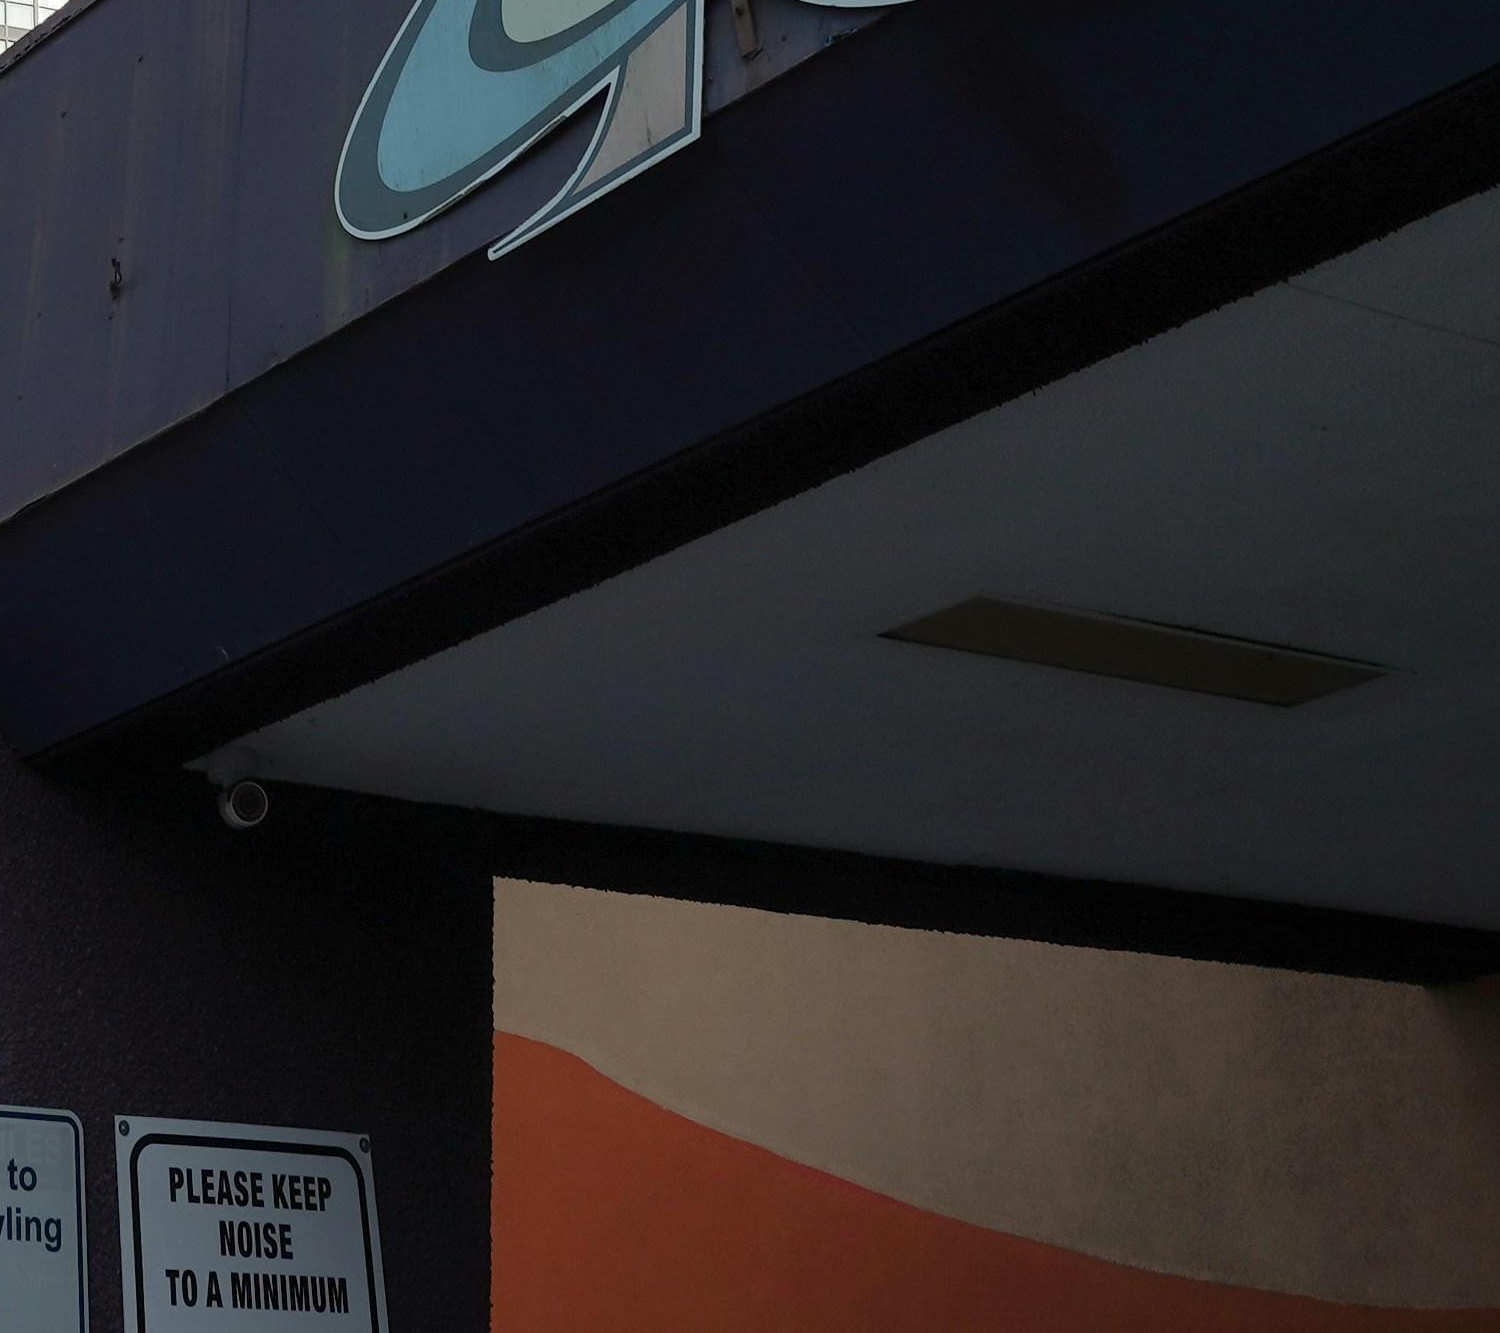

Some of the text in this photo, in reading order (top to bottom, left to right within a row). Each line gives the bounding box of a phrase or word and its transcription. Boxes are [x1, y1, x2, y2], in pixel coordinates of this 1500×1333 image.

[7, 1158, 38, 1191] to
[168, 1167, 332, 1212] PLEASE KEEP
[219, 1220, 294, 1260] NOISE
[165, 1269, 350, 1314] TO A MINIMUM
